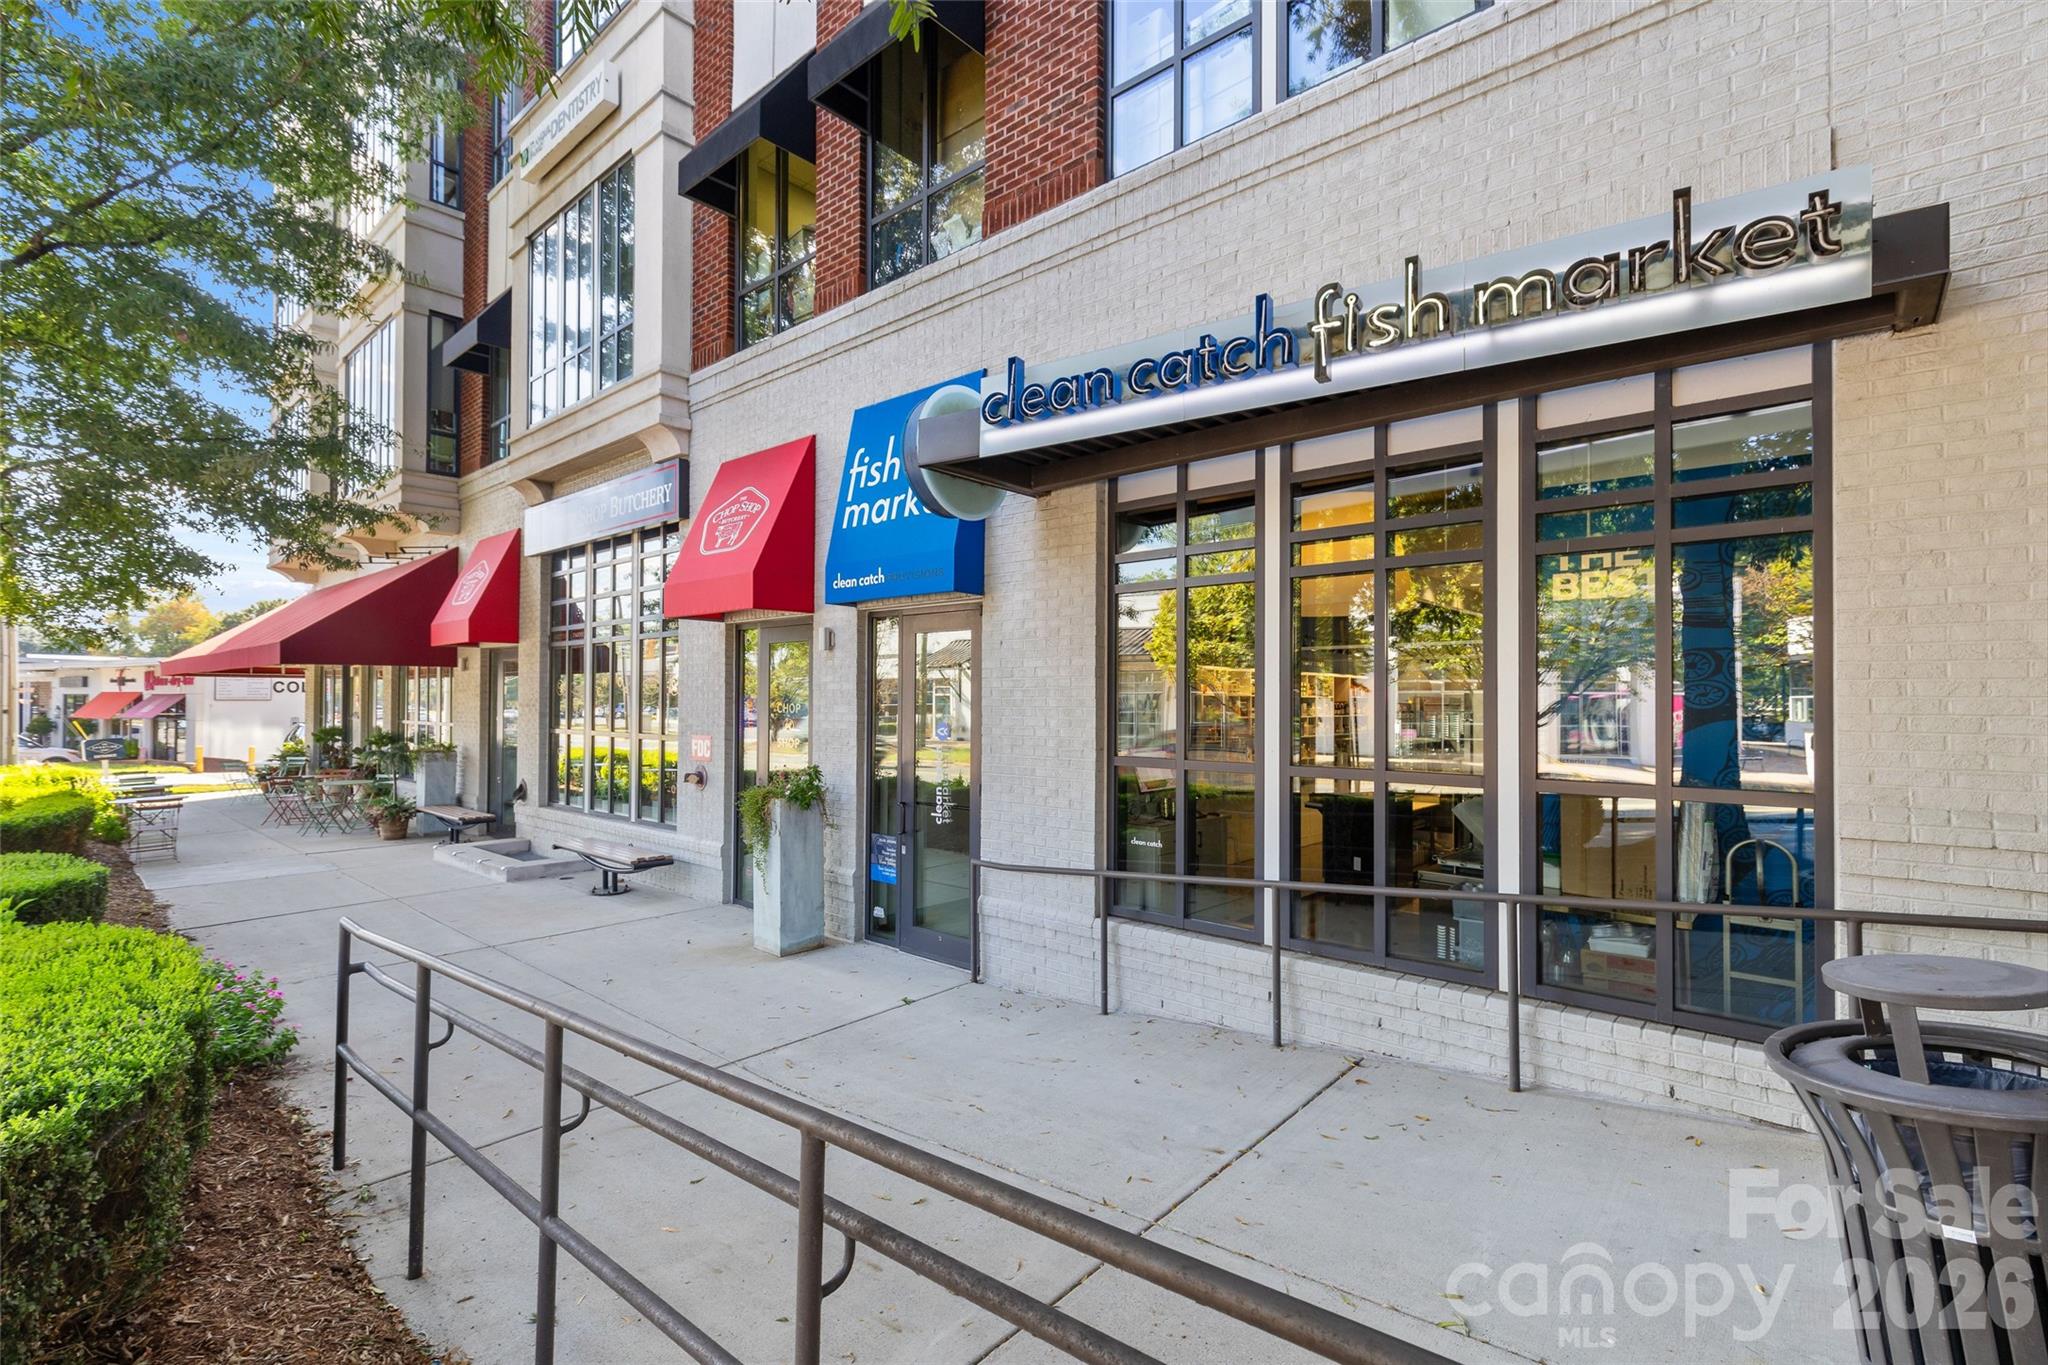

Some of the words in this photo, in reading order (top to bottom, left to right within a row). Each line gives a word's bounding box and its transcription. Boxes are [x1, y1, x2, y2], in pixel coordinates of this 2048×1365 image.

[550, 72, 603, 139] DENTISTRY
[982, 356, 1120, 427] clean
[1128, 293, 1296, 395] catch
[1309, 255, 1453, 382] fish
[1473, 186, 1842, 326] market
[847, 435, 901, 502] fish
[610, 483, 673, 518] BUTCHERY
[842, 486, 932, 529] mark
[832, 572, 858, 589] clean
[859, 567, 885, 587] catch
[776, 702, 801, 714] CHOP
[691, 738, 712, 758] FDC
[930, 786, 943, 825] clean
